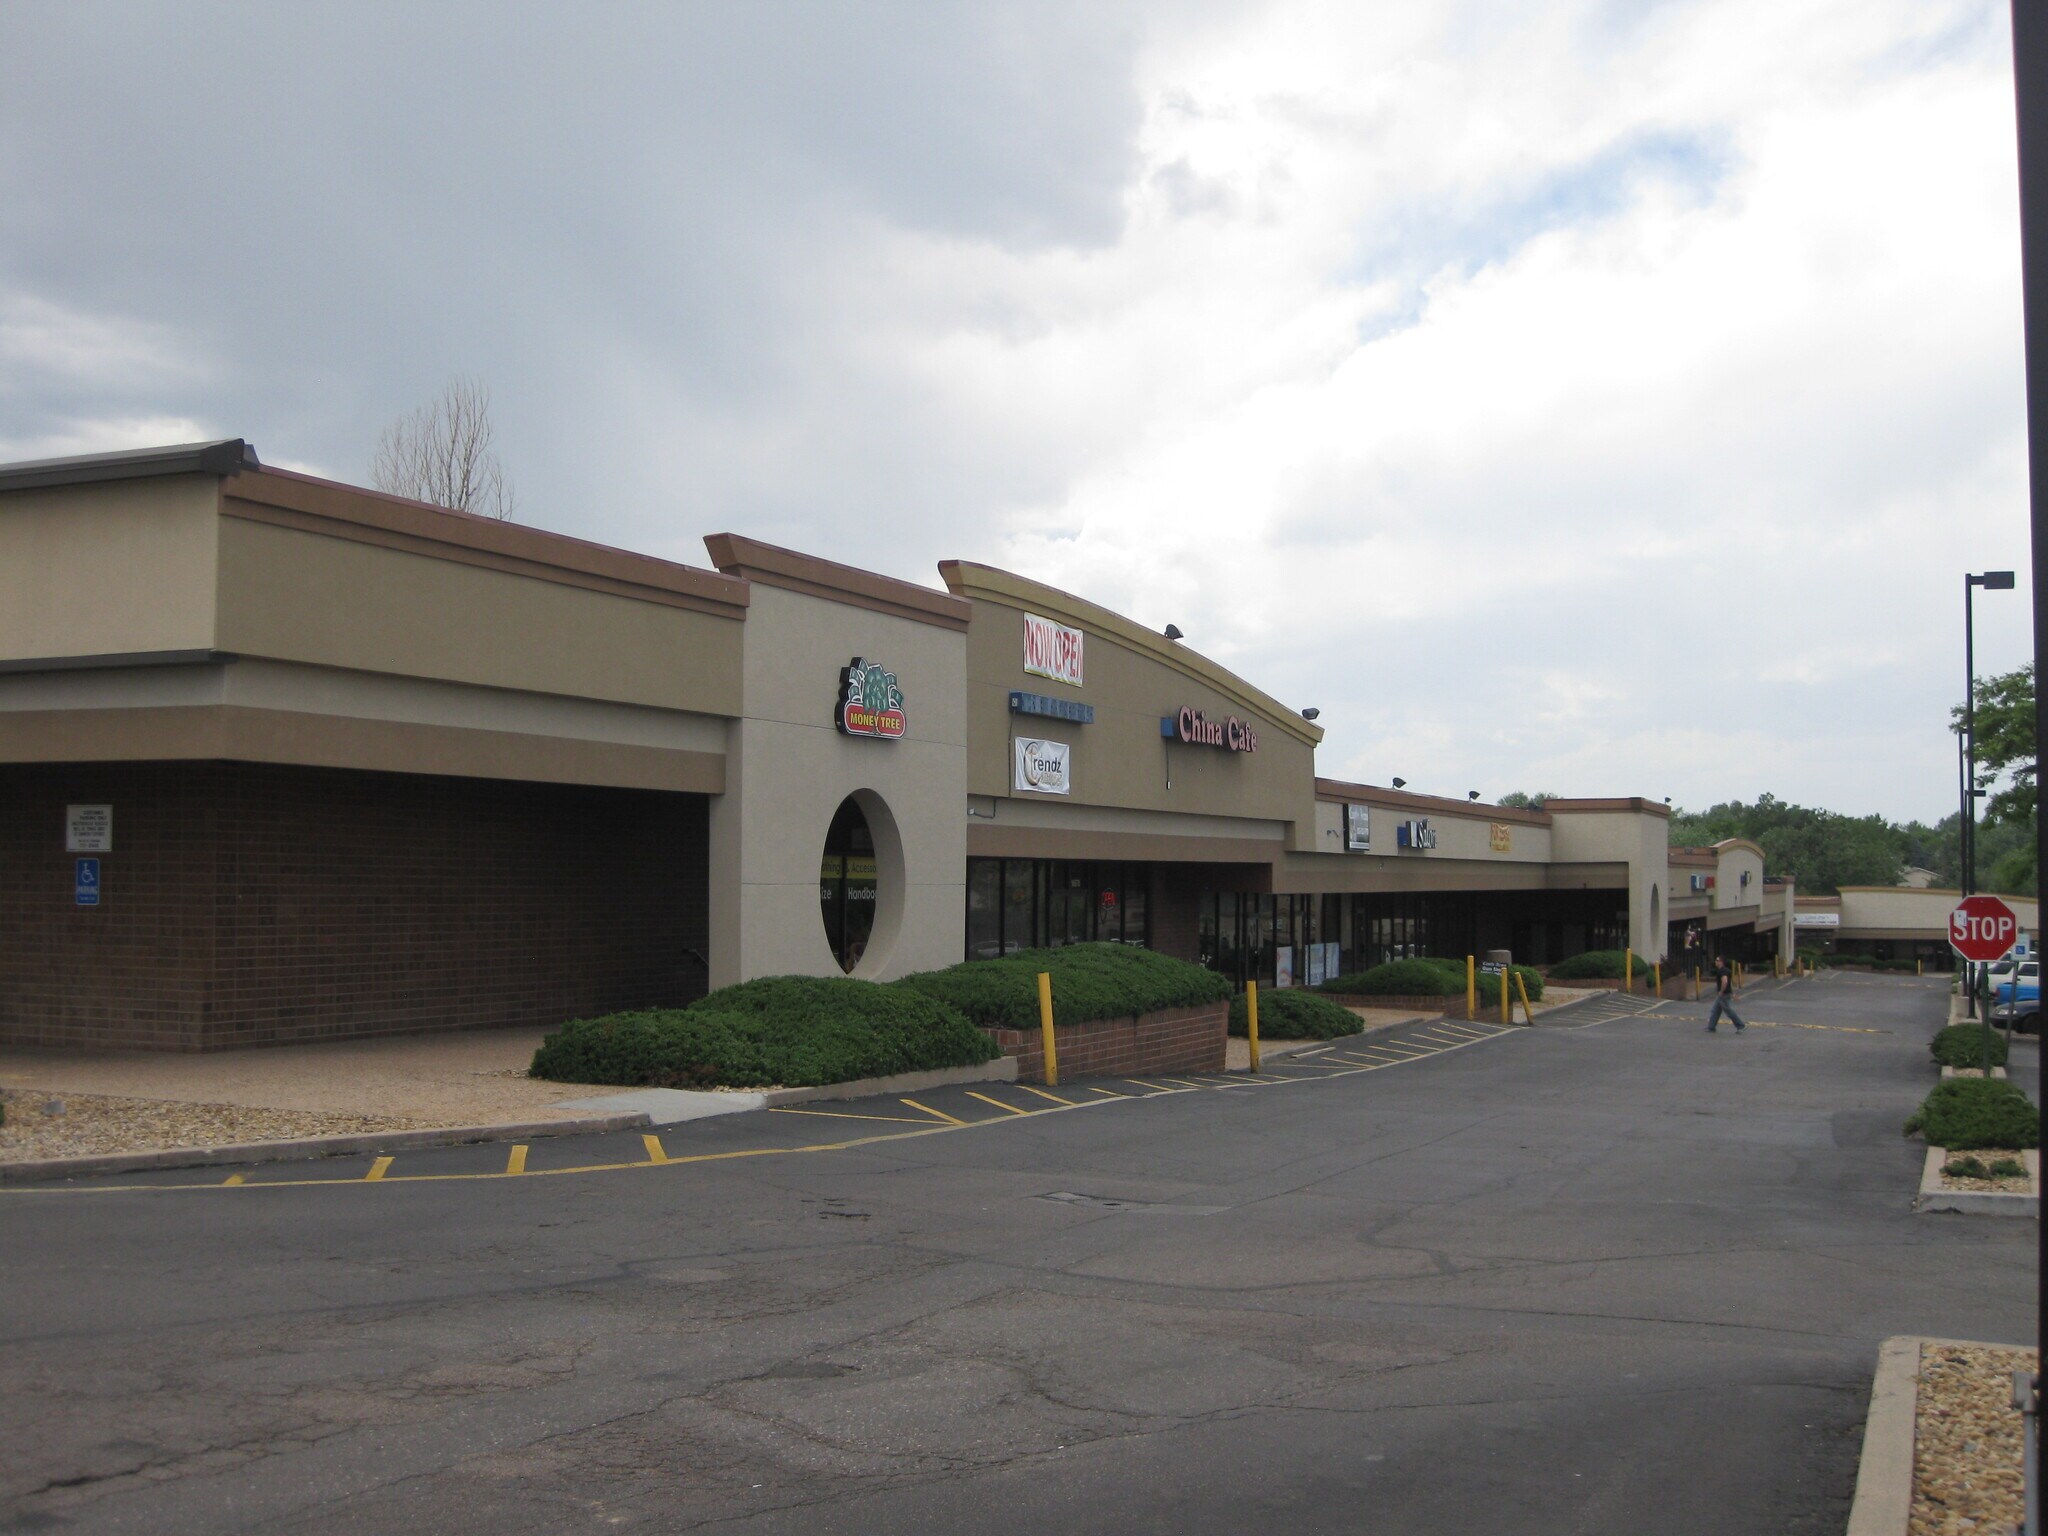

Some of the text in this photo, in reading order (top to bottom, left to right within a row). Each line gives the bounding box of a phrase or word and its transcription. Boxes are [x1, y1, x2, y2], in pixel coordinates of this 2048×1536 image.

[1025, 619, 1083, 679] NOW OPEN
[850, 712, 901, 730] MONEY TREE
[1179, 704, 1258, 752] China Cafe
[847, 886, 877, 900] Handba
[1953, 915, 2012, 941] STOP
